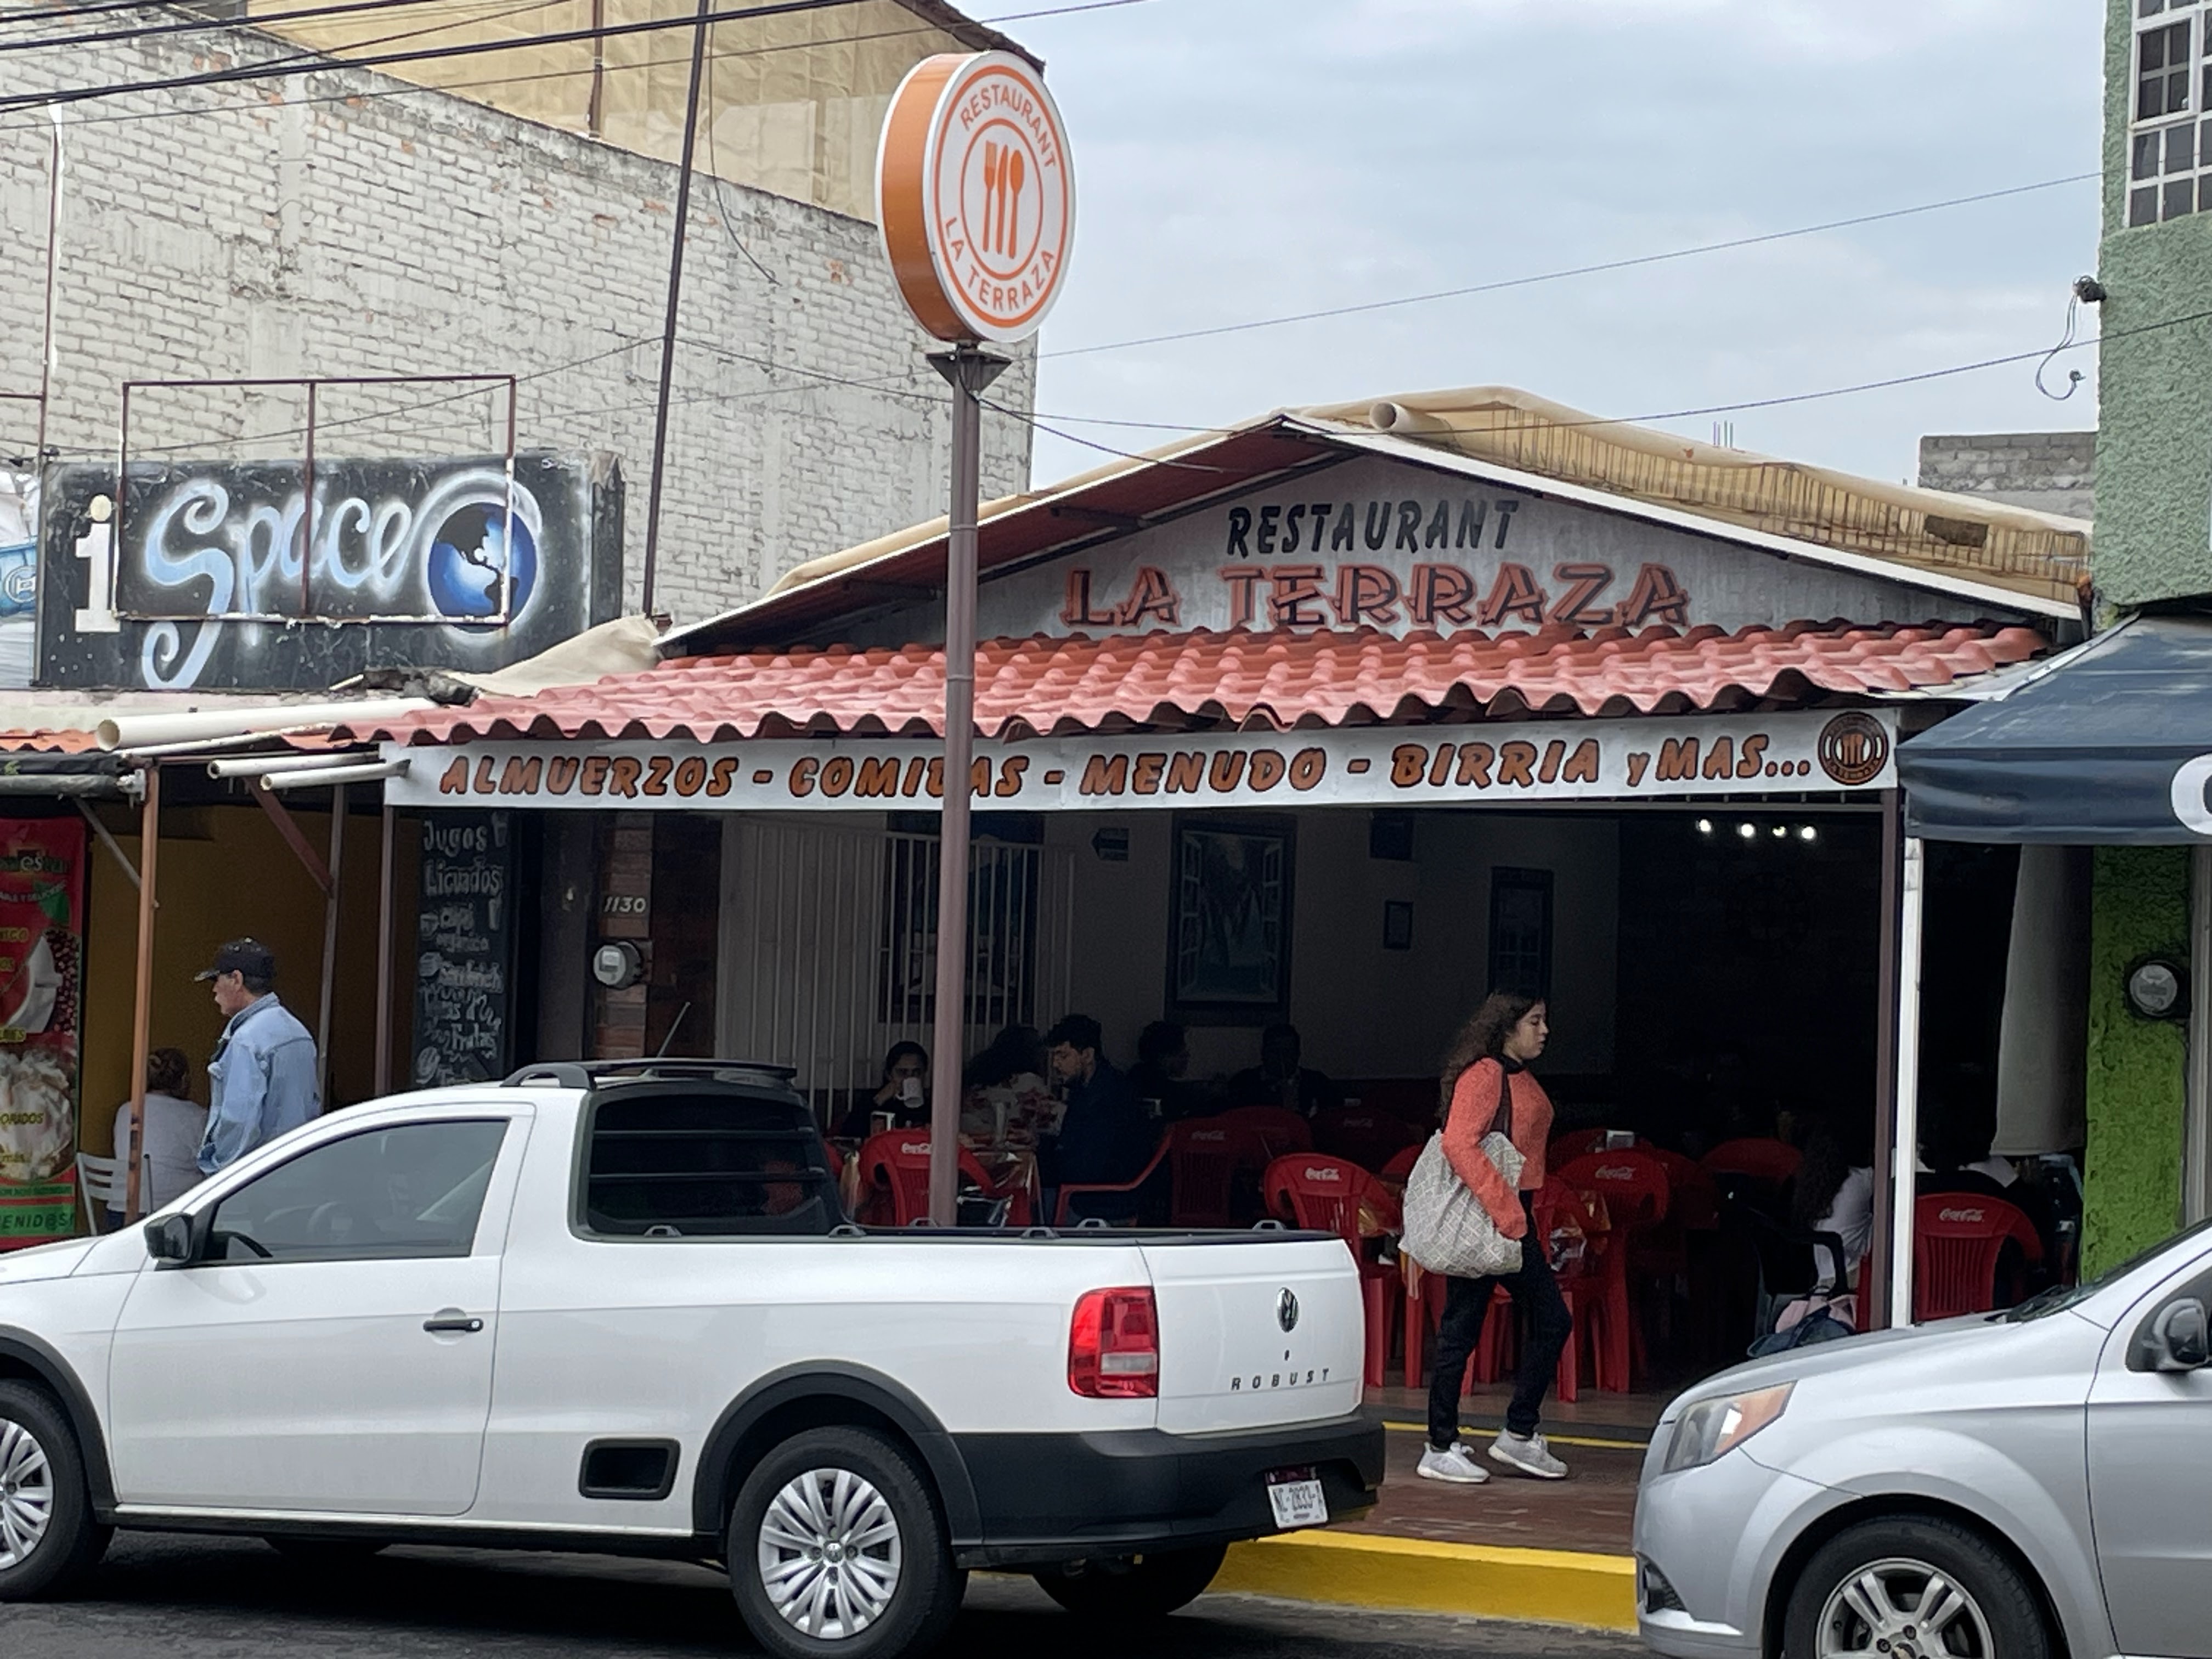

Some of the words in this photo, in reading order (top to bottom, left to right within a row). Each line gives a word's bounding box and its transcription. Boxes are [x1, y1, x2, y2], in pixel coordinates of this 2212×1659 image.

[960, 83, 1056, 168] RESTAURANT
[944, 216, 962, 261] LA
[966, 249, 1055, 312] TERRAZA
[1227, 500, 1519, 558] RESTAURANT
[1059, 566, 1182, 627] LA
[1217, 562, 1691, 629] TERRAZA
[439, 755, 739, 799] ALMUERZOS
[1080, 747, 1327, 795] MENUDO
[1391, 738, 1599, 789] BIRRIA
[424, 820, 488, 857] Jugos
[603, 896, 646, 913] 1130
[1231, 1368, 1329, 1390] ROBUST
